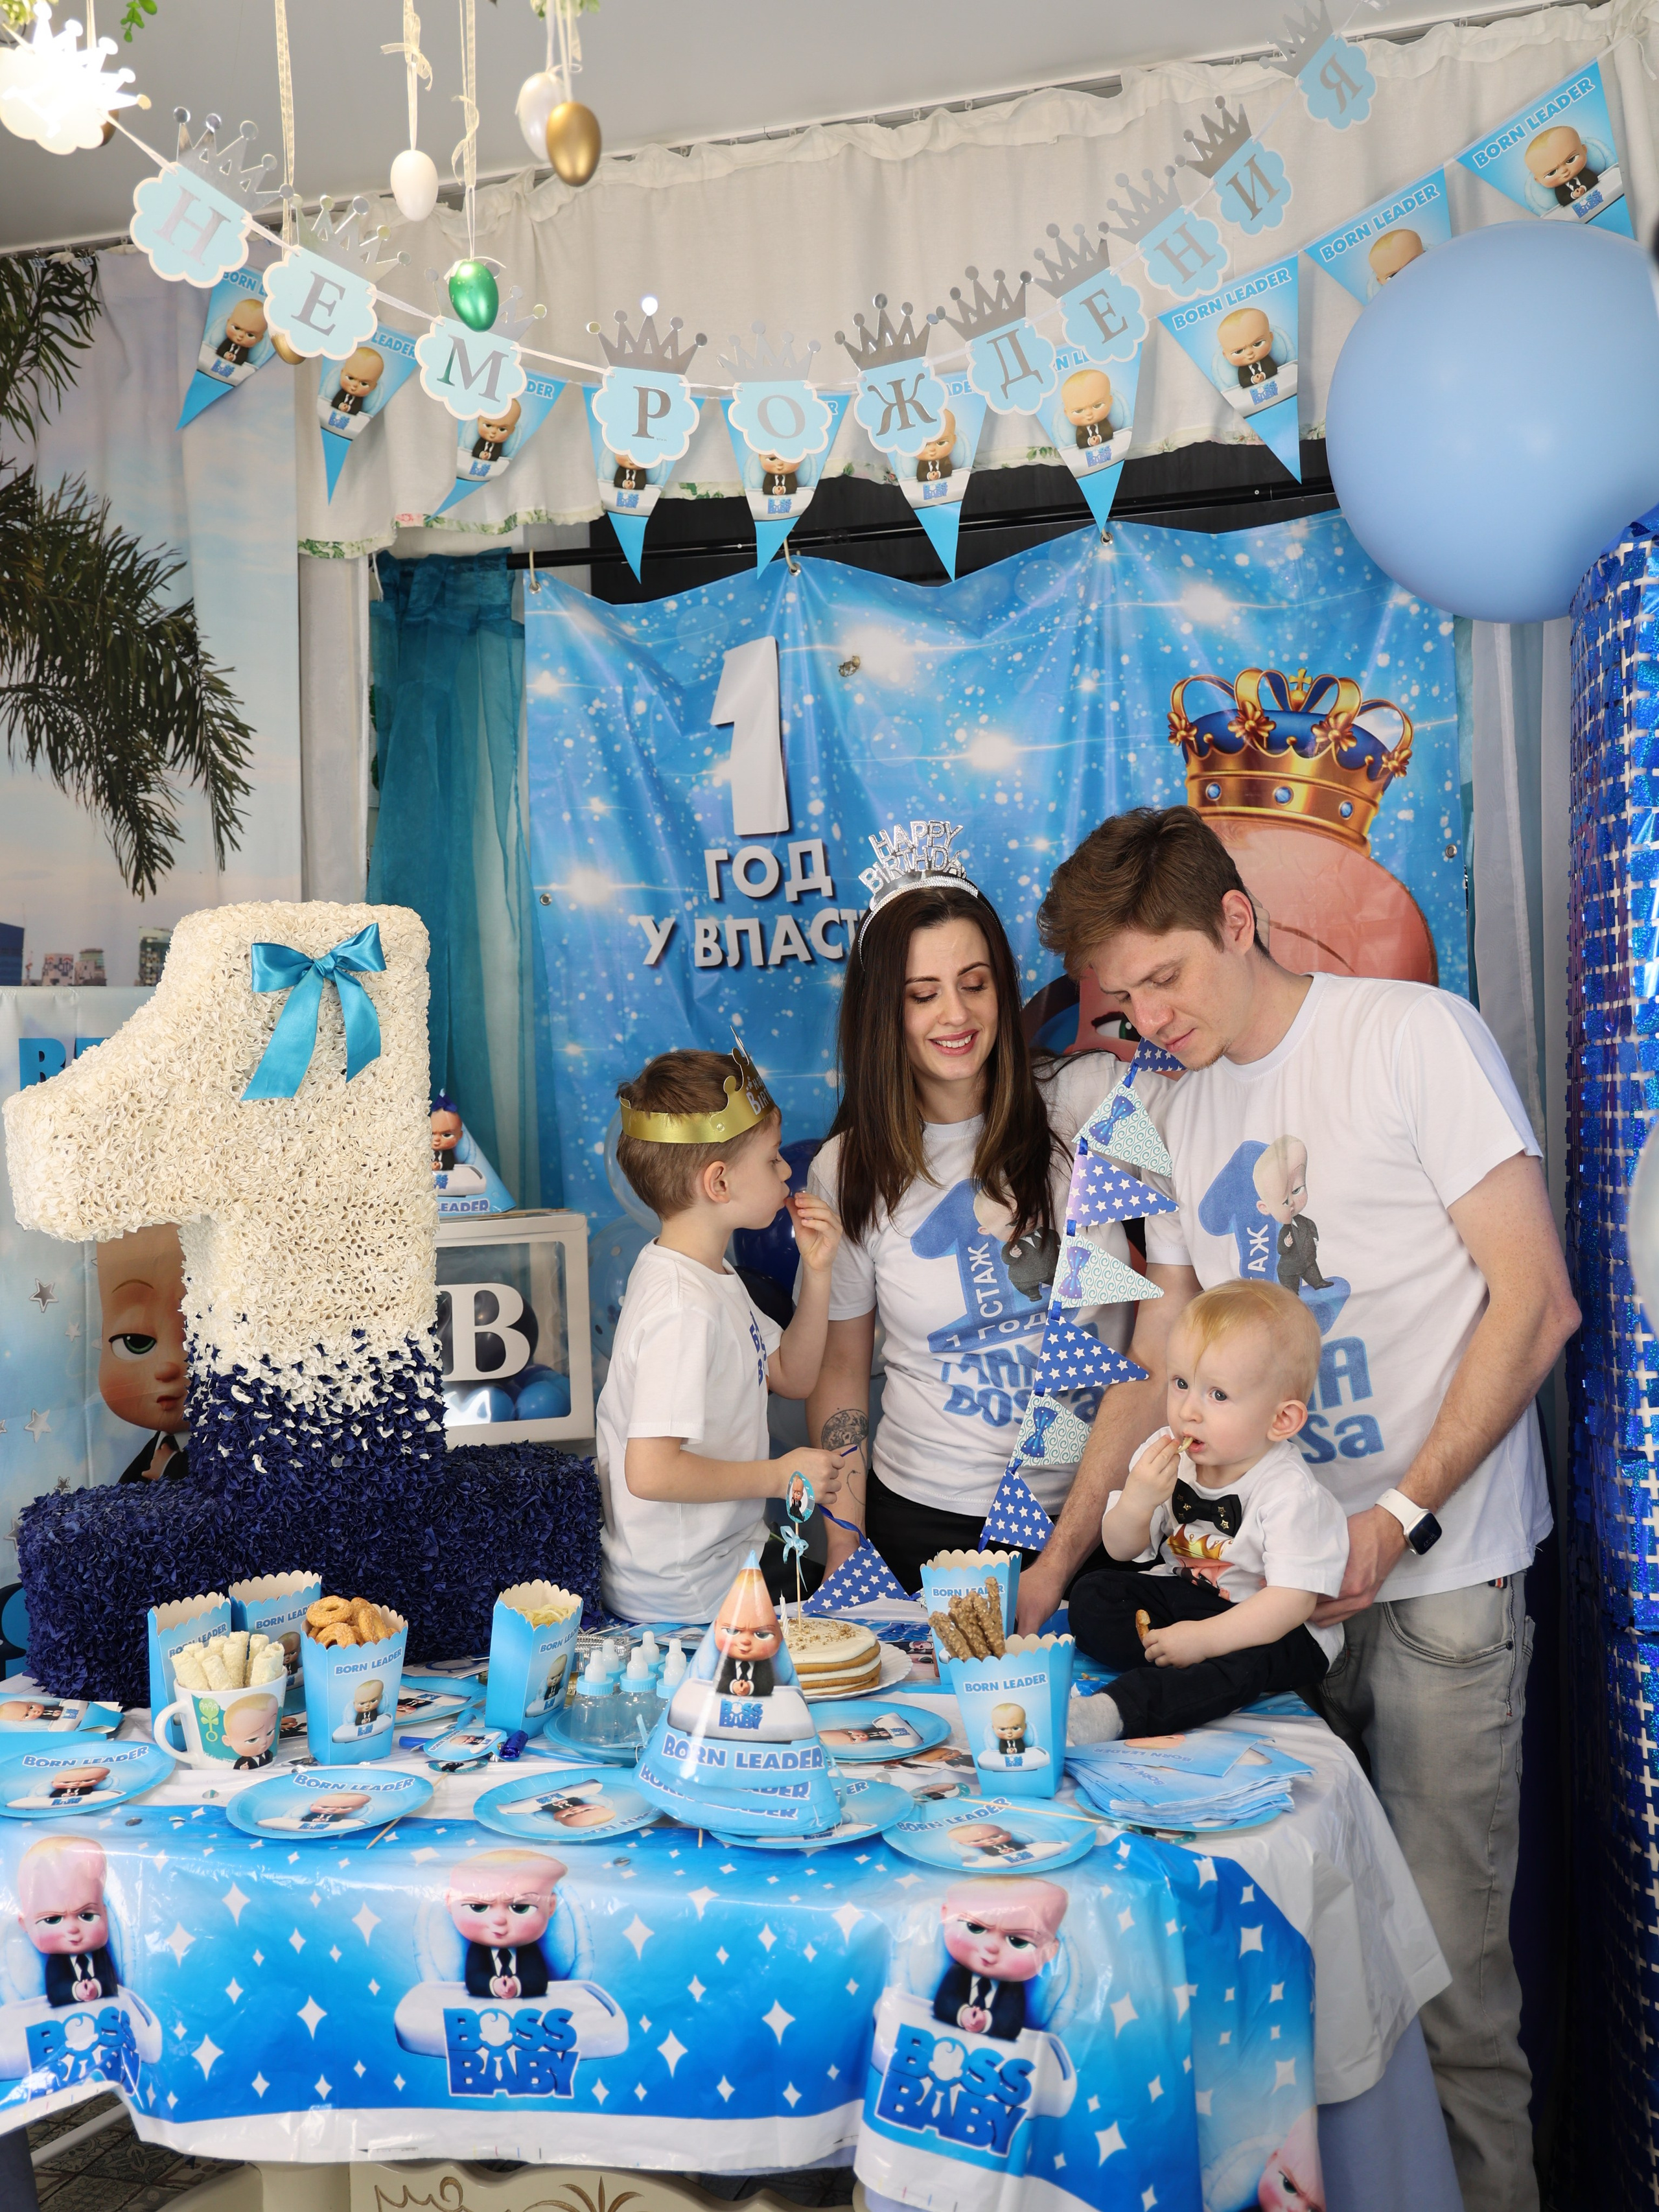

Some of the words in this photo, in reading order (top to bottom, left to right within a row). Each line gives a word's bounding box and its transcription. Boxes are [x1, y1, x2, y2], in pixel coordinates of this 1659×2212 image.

[1472, 123, 1526, 169] BORN
[1526, 77, 1595, 131] LEADER
[1320, 224, 1372, 262] BORN
[1373, 183, 1440, 231] LEADER
[1172, 296, 1224, 330] BORN
[1225, 268, 1292, 307] LEADER
[711, 636, 789, 835] 1
[868, 820, 963, 864] HAPPY
[704, 839, 833, 902] ГОД
[637, 914, 676, 965] У
[695, 907, 866, 968] ВЛАСТ
[438, 1198, 489, 1213] EADER
[968, 1242, 1003, 1319] СТАЖ
[438, 1283, 530, 1382] B
[946, 1334, 961, 1347] 1
[978, 1312, 1047, 1340] ГОД
[932, 1587, 963, 1598] BORN
[255, 1615, 284, 1630] BORN
[288, 1604, 312, 1622] LEAD
[168, 1640, 196, 1659] BO
[198, 1622, 227, 1643] LEADER
[539, 1639, 563, 1653] BORN
[334, 1662, 367, 1675] BORN
[371, 1647, 402, 1668] LEADER
[964, 1682, 999, 1694] BORN
[1003, 1673, 1047, 1690] LEADER
[719, 1712, 763, 1730] BABY
[720, 1699, 763, 1716] BOSS
[22, 1754, 77, 1767] BORN
[82, 1746, 149, 1765] LEADER
[661, 1732, 727, 1767] BORN
[734, 1745, 825, 1771] LEADER
[294, 1773, 347, 1790] BORN
[350, 1778, 415, 1791] LEADER
[896, 1821, 943, 1833] BORN
[945, 1797, 1012, 1826] LEADER
[443, 2007, 577, 2053] BOSS
[448, 2045, 581, 2098] BABY
[894, 2023, 1036, 2106] BOSS
[875, 2074, 1027, 2157] BABY
